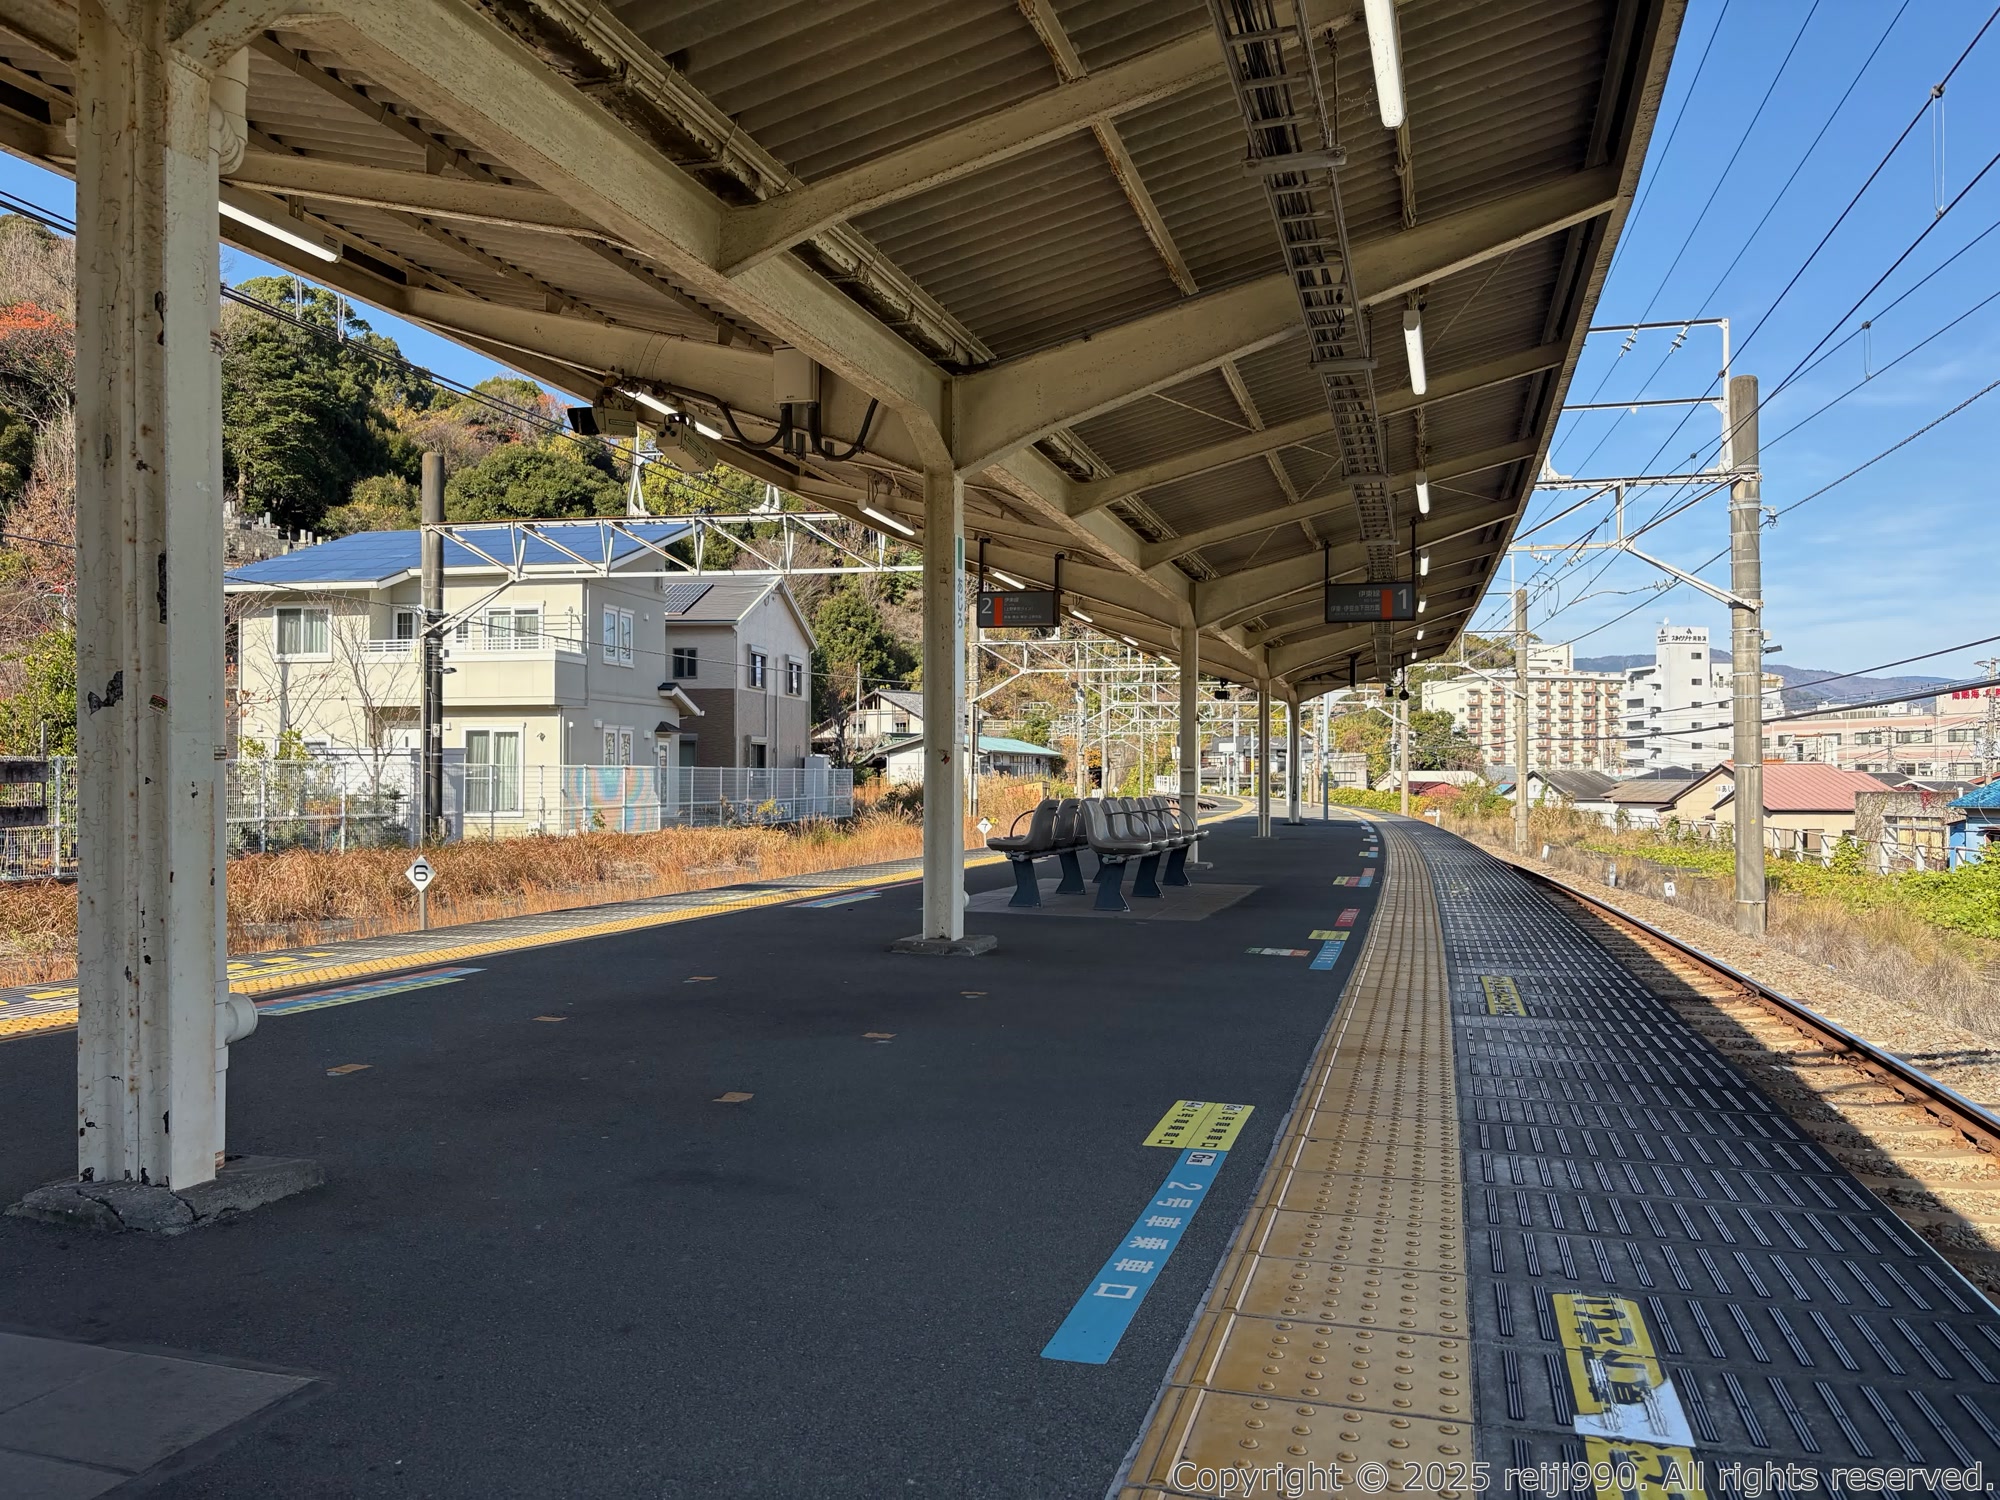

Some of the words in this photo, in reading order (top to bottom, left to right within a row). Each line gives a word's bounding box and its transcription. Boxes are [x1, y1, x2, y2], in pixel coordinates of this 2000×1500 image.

[981, 597, 992, 614] 2
[1397, 588, 1407, 610] 1
[981, 823, 988, 832] 7
[413, 864, 429, 882] 6
[1667, 884, 1673, 892] 4
[1093, 1181, 1204, 1300] 2号車乗車口
